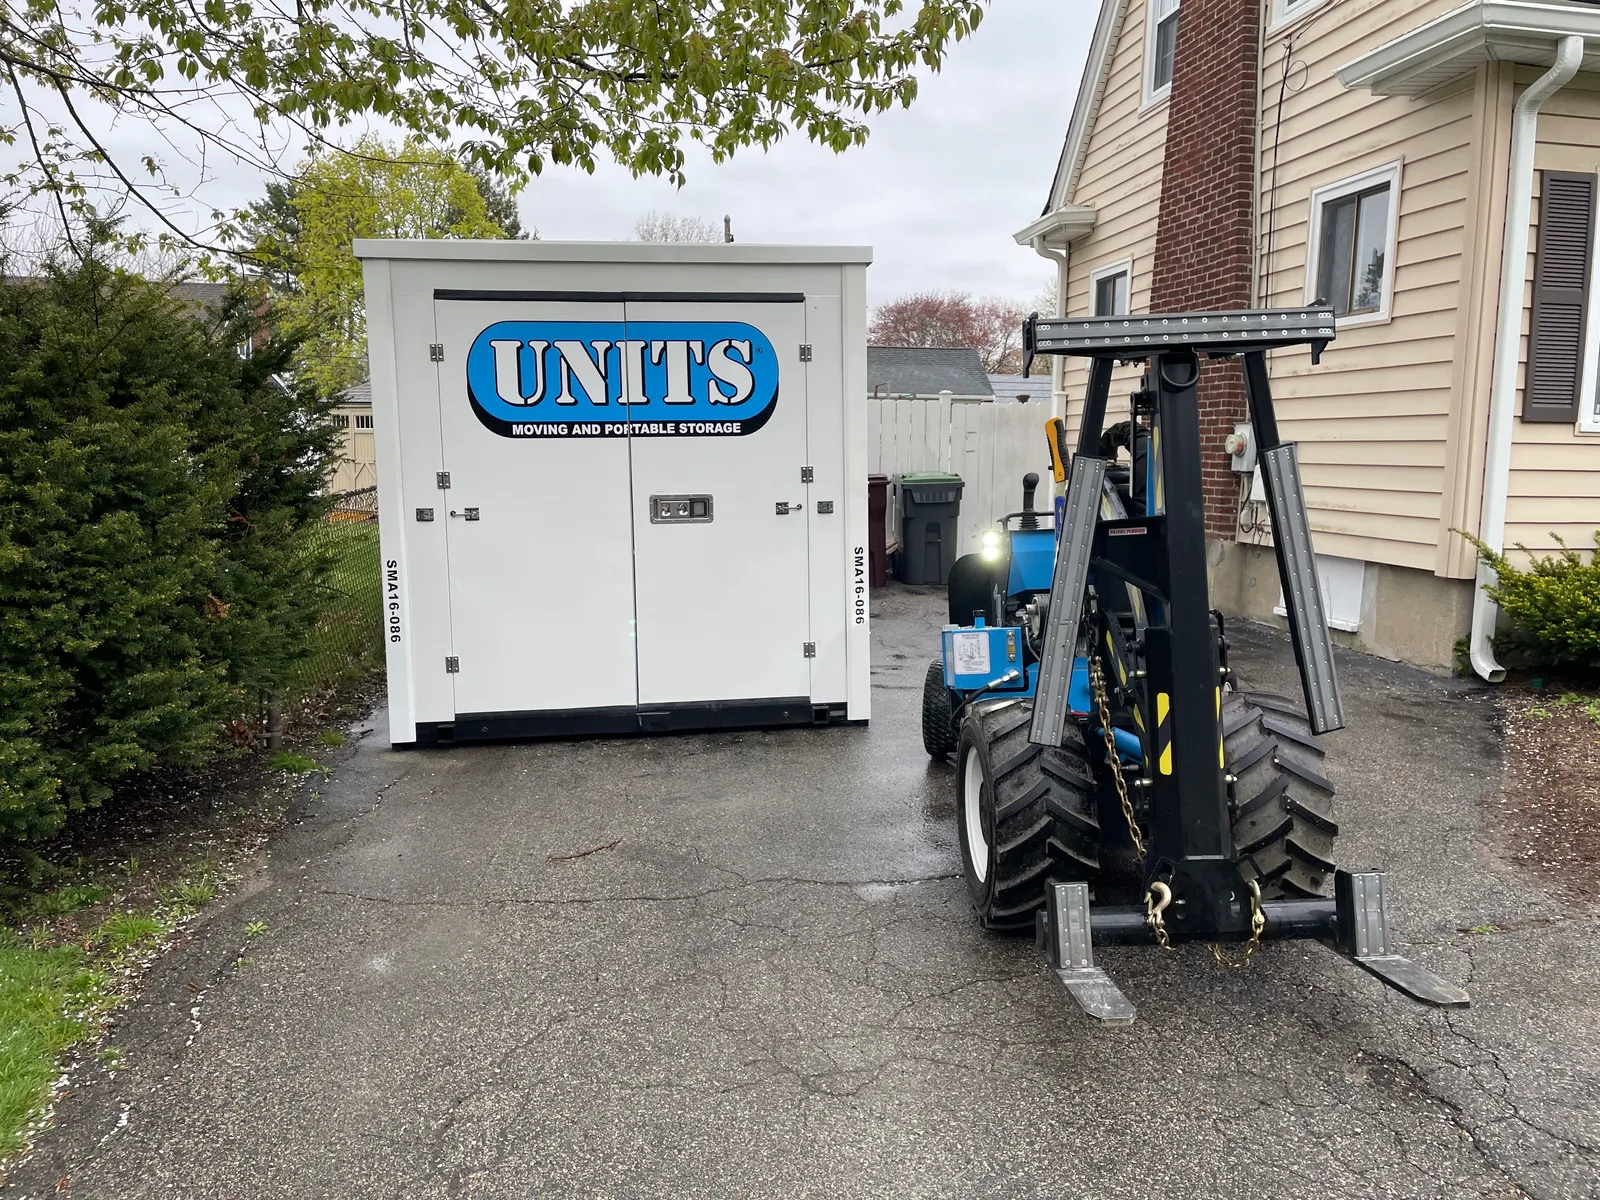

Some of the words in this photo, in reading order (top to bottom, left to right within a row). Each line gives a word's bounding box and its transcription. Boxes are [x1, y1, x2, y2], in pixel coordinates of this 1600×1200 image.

[489, 338, 756, 407] UNITS
[512, 424, 568, 436] MOVING
[571, 424, 601, 436] AND
[604, 423, 676, 435] PORTABLE
[678, 422, 741, 434] STORAGE
[386, 559, 402, 643] SMA16-086
[854, 546, 865, 625] SMA16-086
